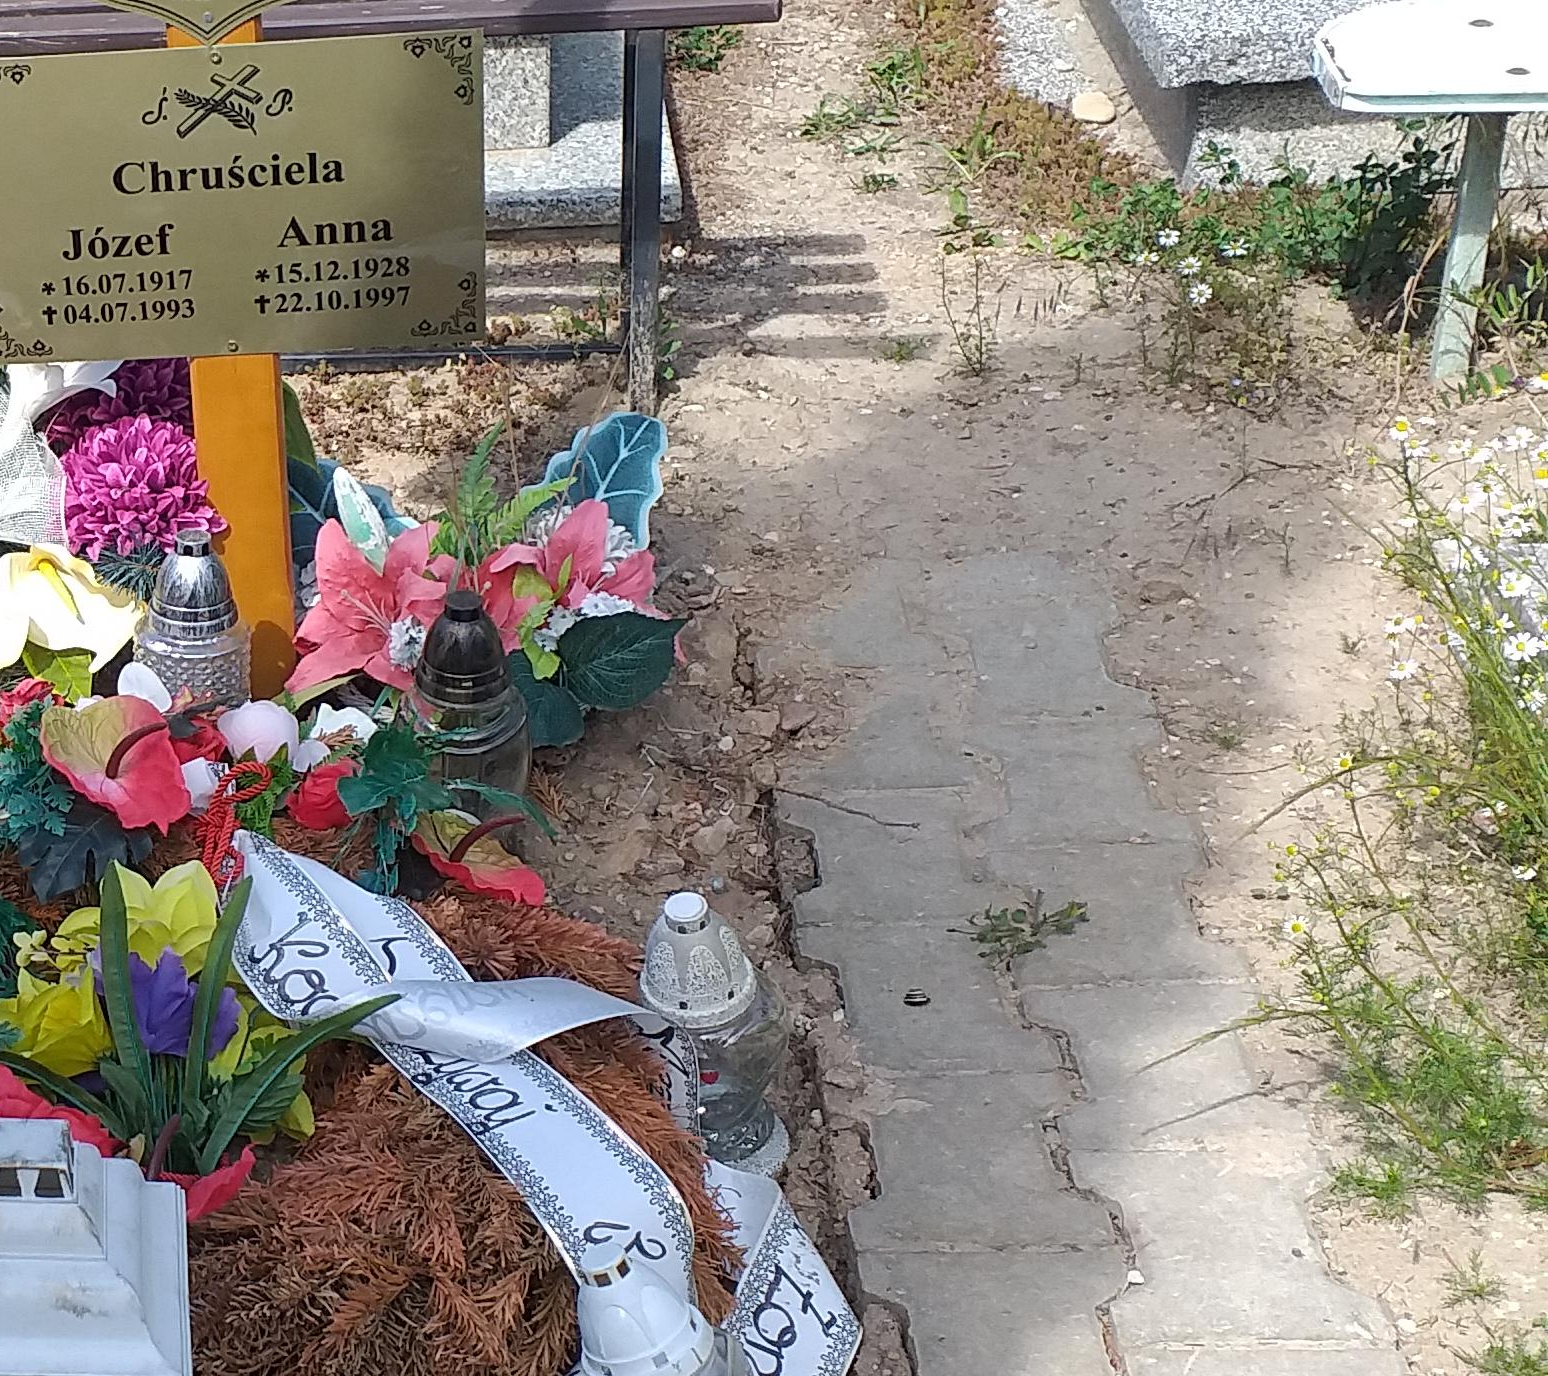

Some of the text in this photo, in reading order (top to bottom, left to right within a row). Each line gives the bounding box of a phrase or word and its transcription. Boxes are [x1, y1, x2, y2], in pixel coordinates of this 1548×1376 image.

[112, 152, 345, 197] Chruściela
[61, 215, 394, 261] Józef Anna
[62, 256, 411, 297] 16.07.1917 15.12.1928
[63, 285, 412, 325] 04.07.1993 22.10.1997
